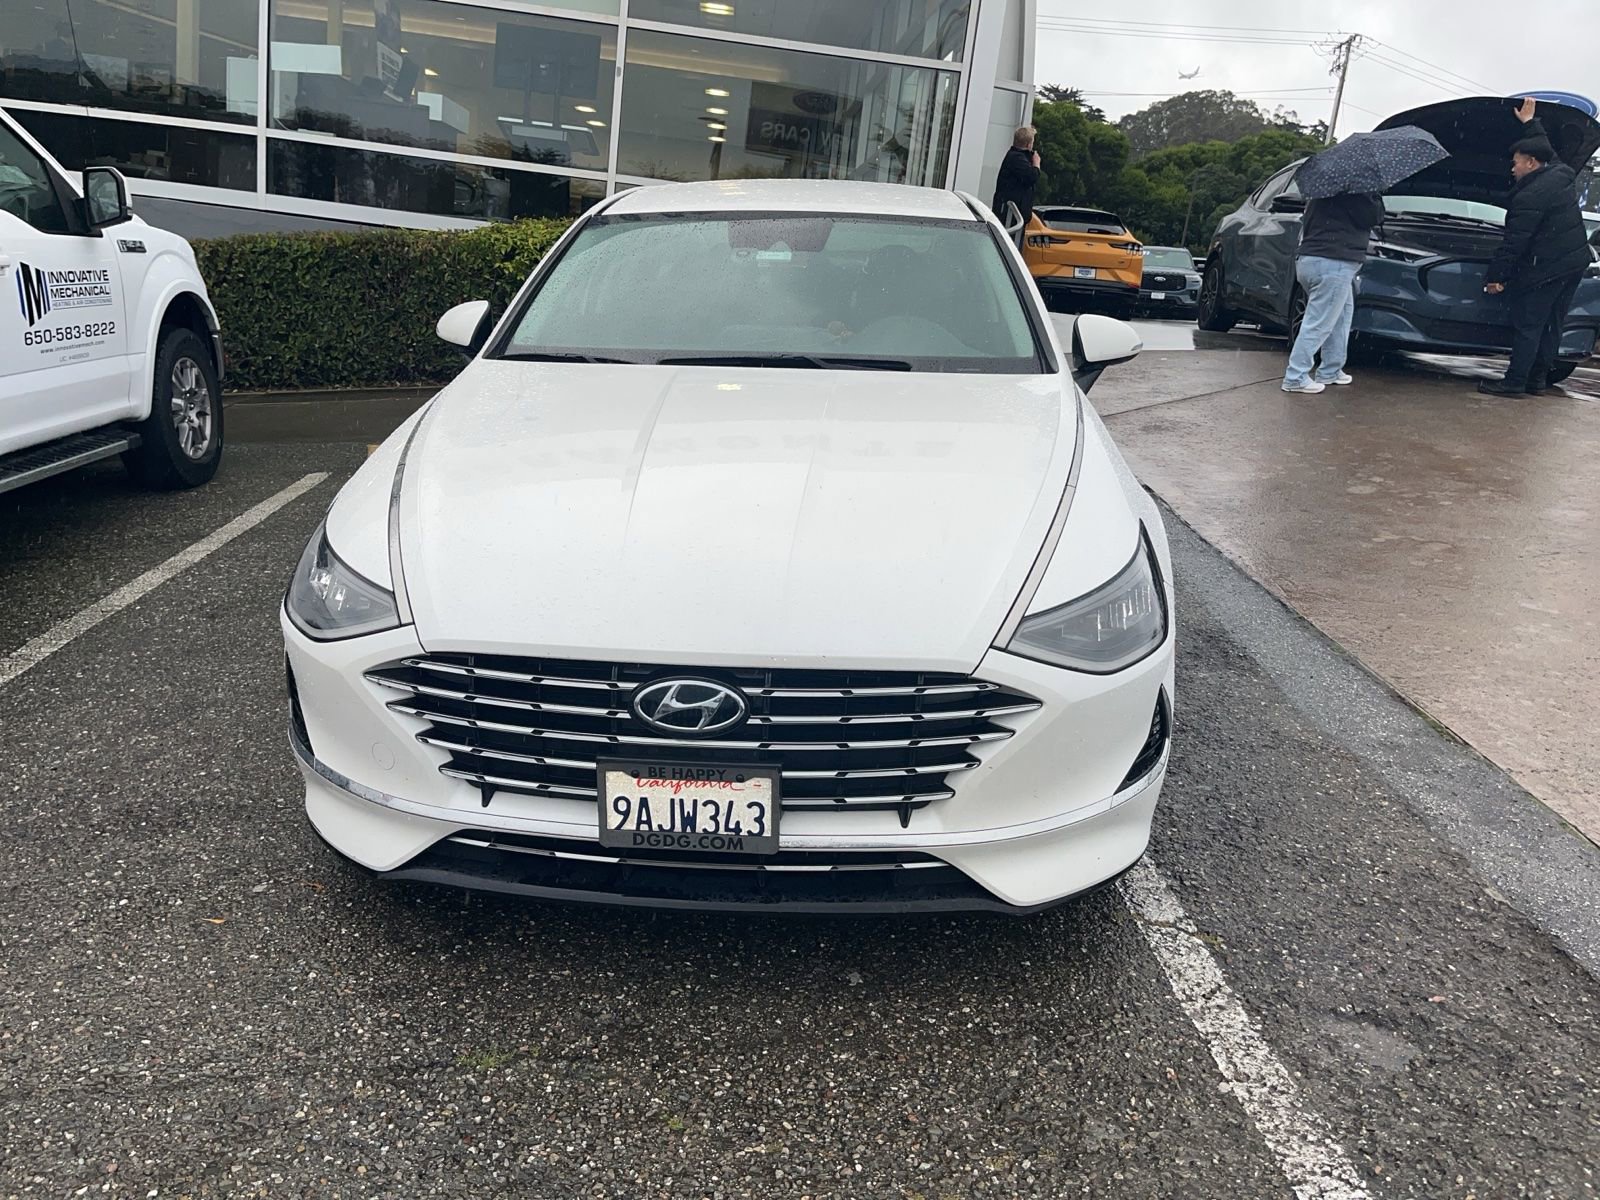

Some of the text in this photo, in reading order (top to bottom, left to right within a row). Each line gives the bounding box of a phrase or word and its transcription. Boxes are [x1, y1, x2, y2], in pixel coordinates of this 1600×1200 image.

[47, 269, 110, 284] INNOVATIVE
[50, 285, 111, 299] MECHANICAL
[24, 321, 116, 346] 650-583-8222
[648, 766, 728, 781] BE HAPPY
[612, 795, 766, 837] 9AJW343
[632, 832, 744, 851] DGDG.COM
